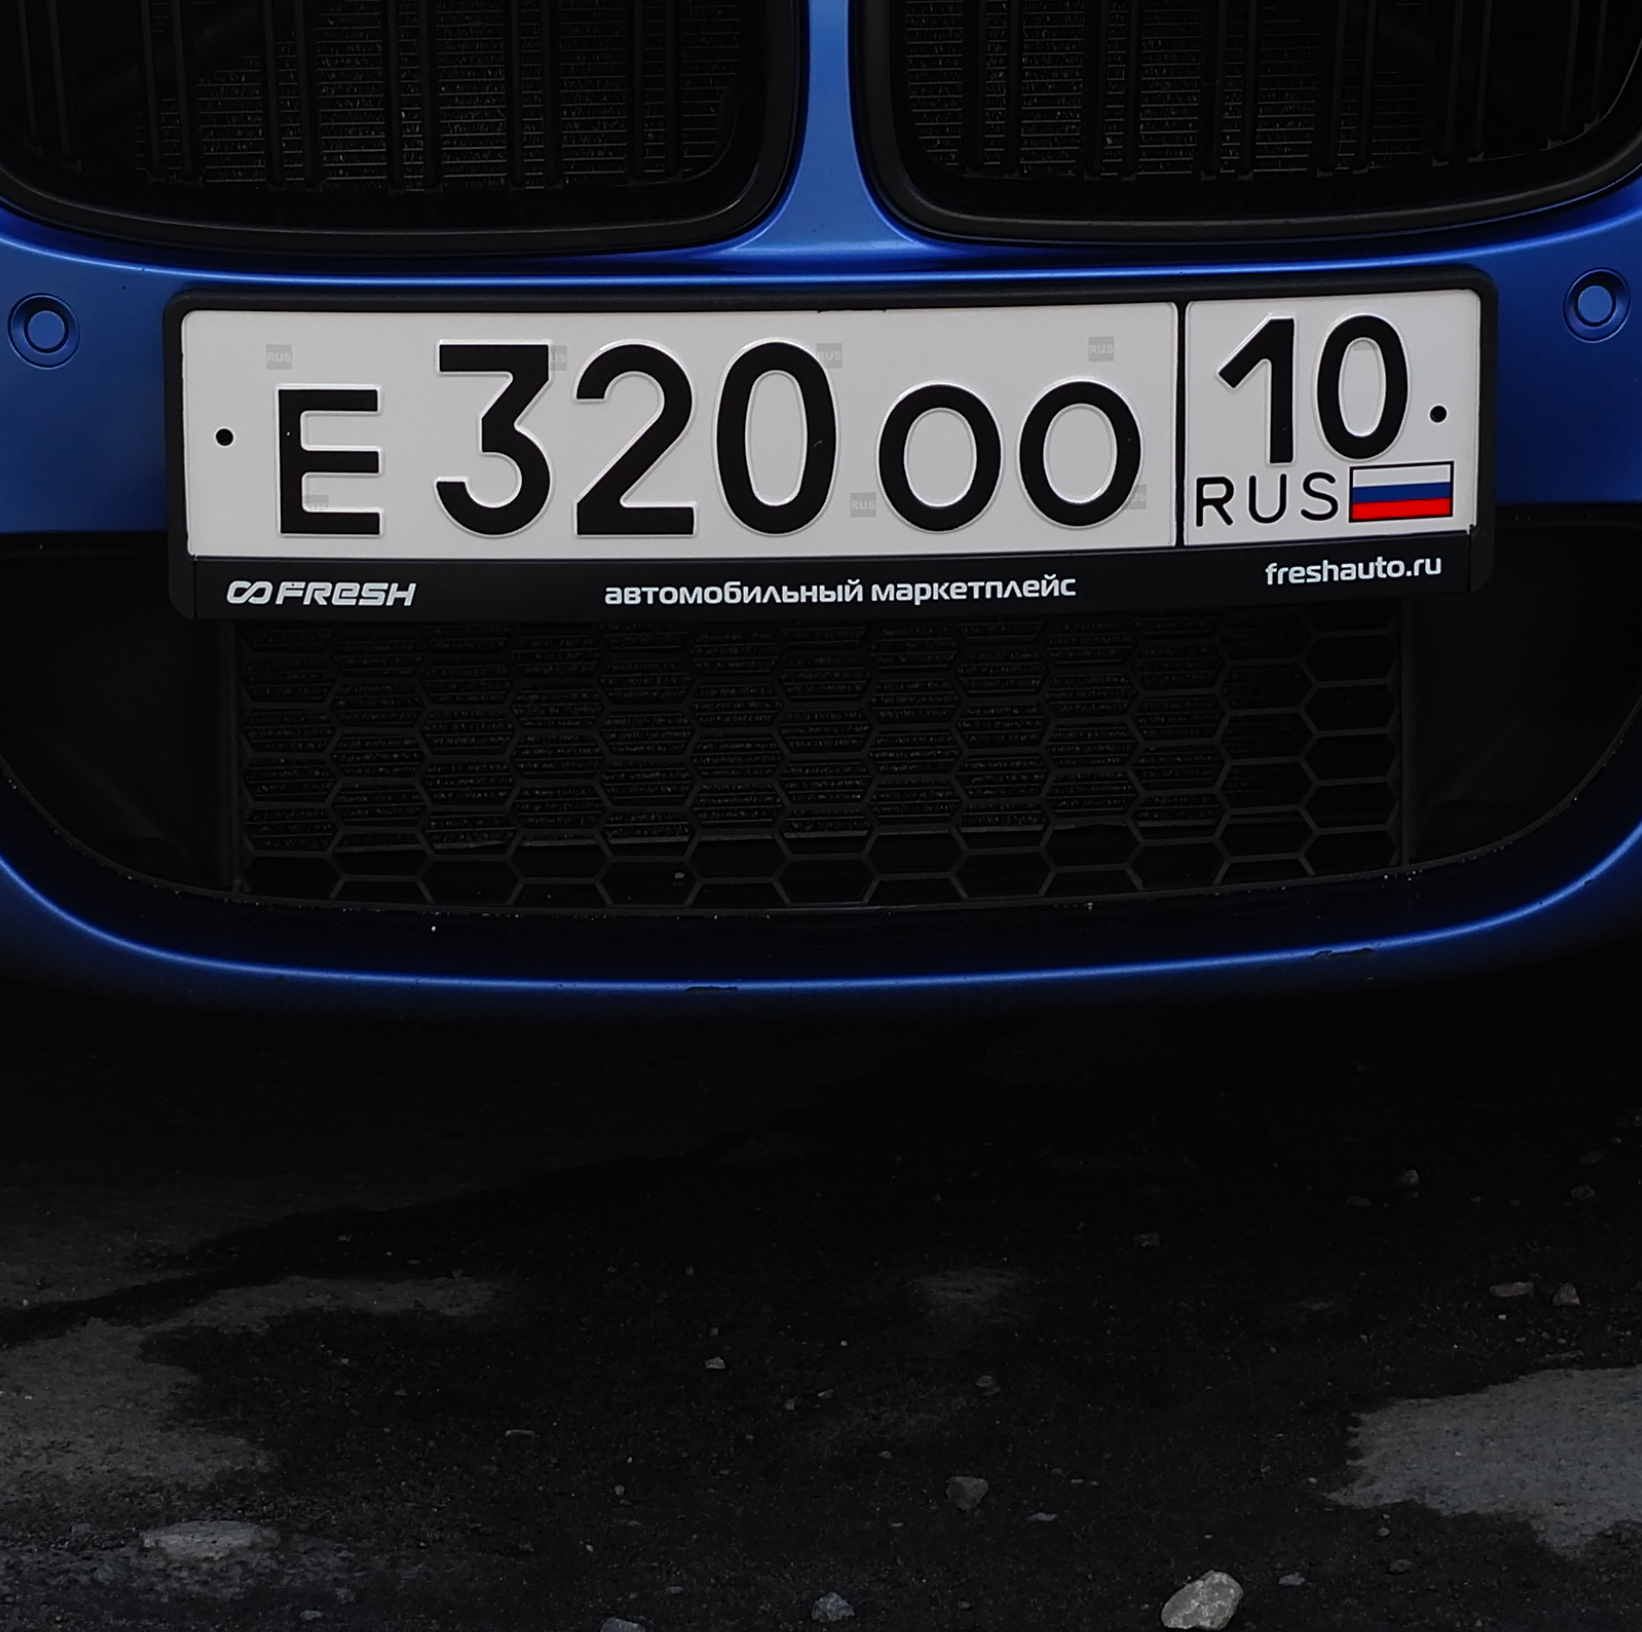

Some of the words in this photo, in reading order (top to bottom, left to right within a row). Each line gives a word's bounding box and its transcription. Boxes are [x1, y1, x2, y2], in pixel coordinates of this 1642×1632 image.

[1218, 314, 1409, 464] 10
[1196, 472, 1338, 527] RUS
[605, 579, 863, 604] автомобильный
[872, 574, 1076, 605] маркетплейс
[1265, 556, 1442, 586] freshauto.ru
